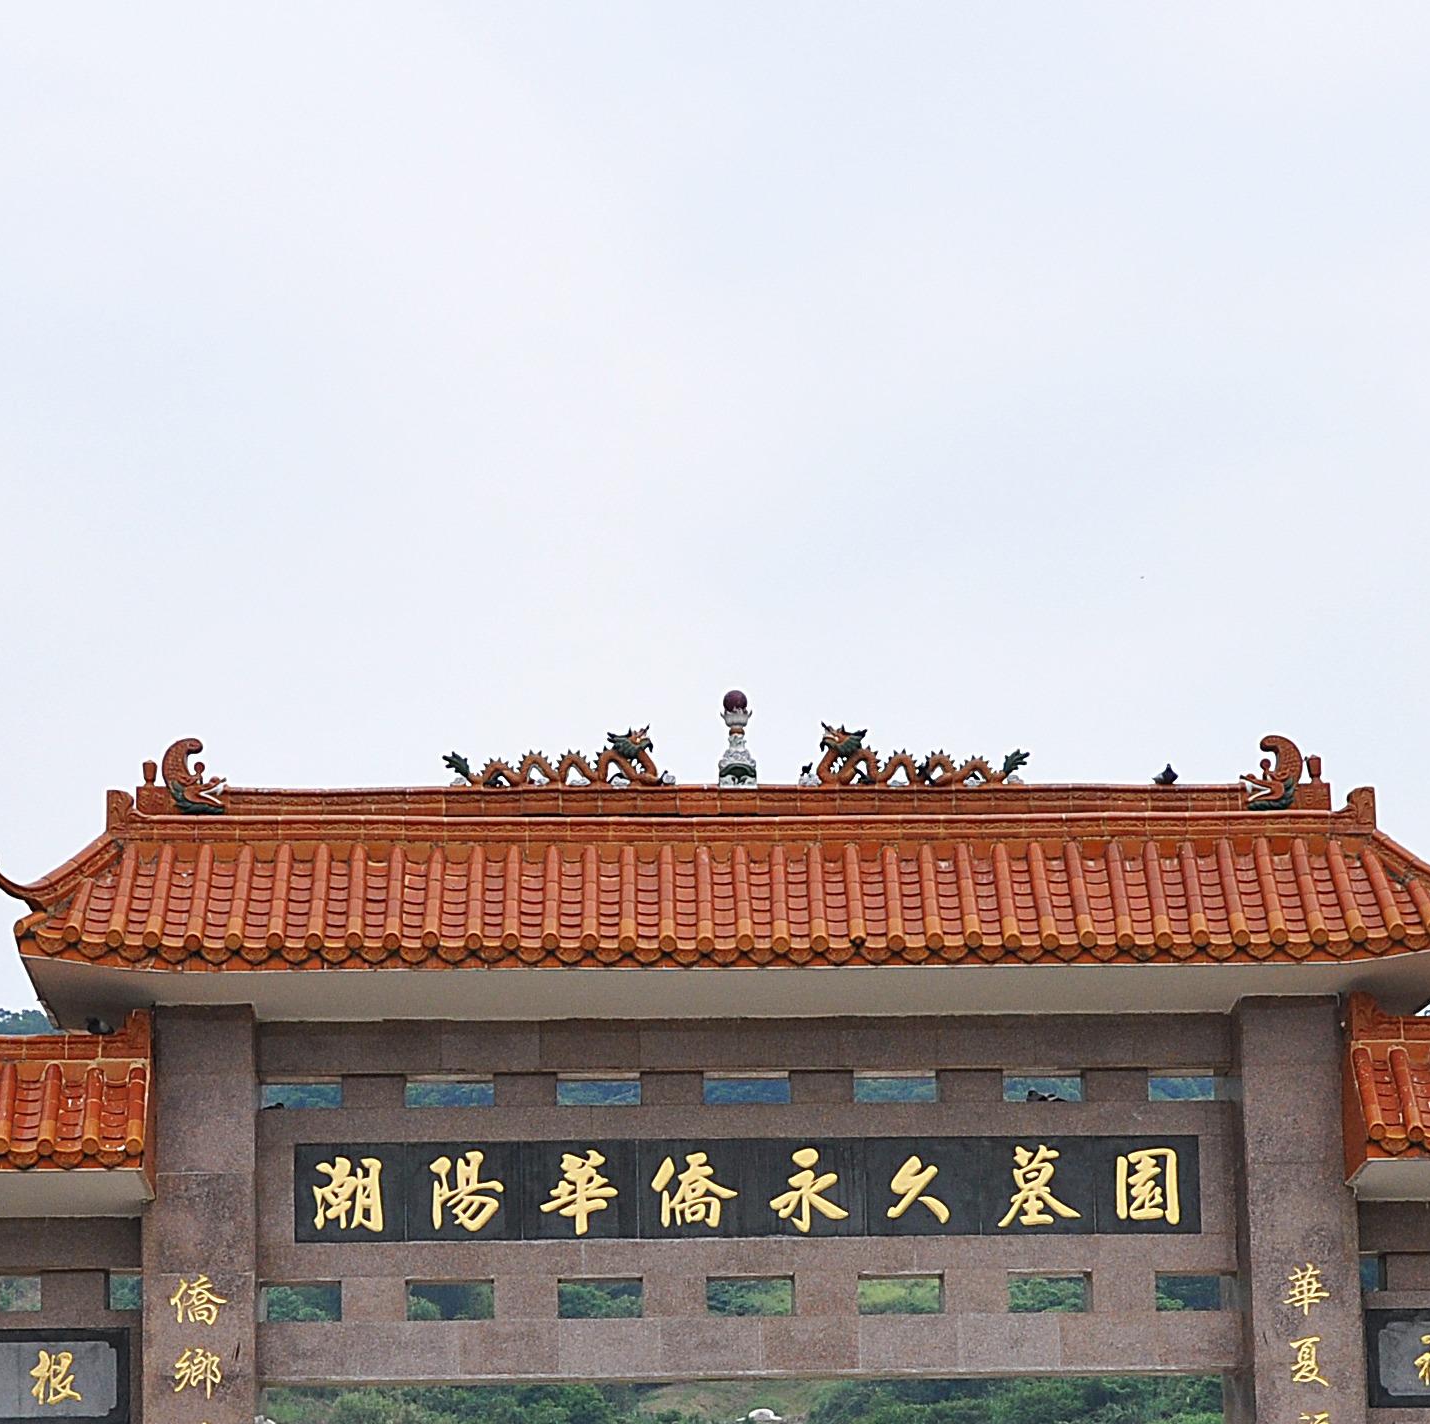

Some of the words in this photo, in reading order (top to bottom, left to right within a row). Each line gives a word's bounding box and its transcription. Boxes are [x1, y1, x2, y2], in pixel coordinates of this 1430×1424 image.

[312, 1148, 1180, 1236] 潮陽華僑永久墓園
